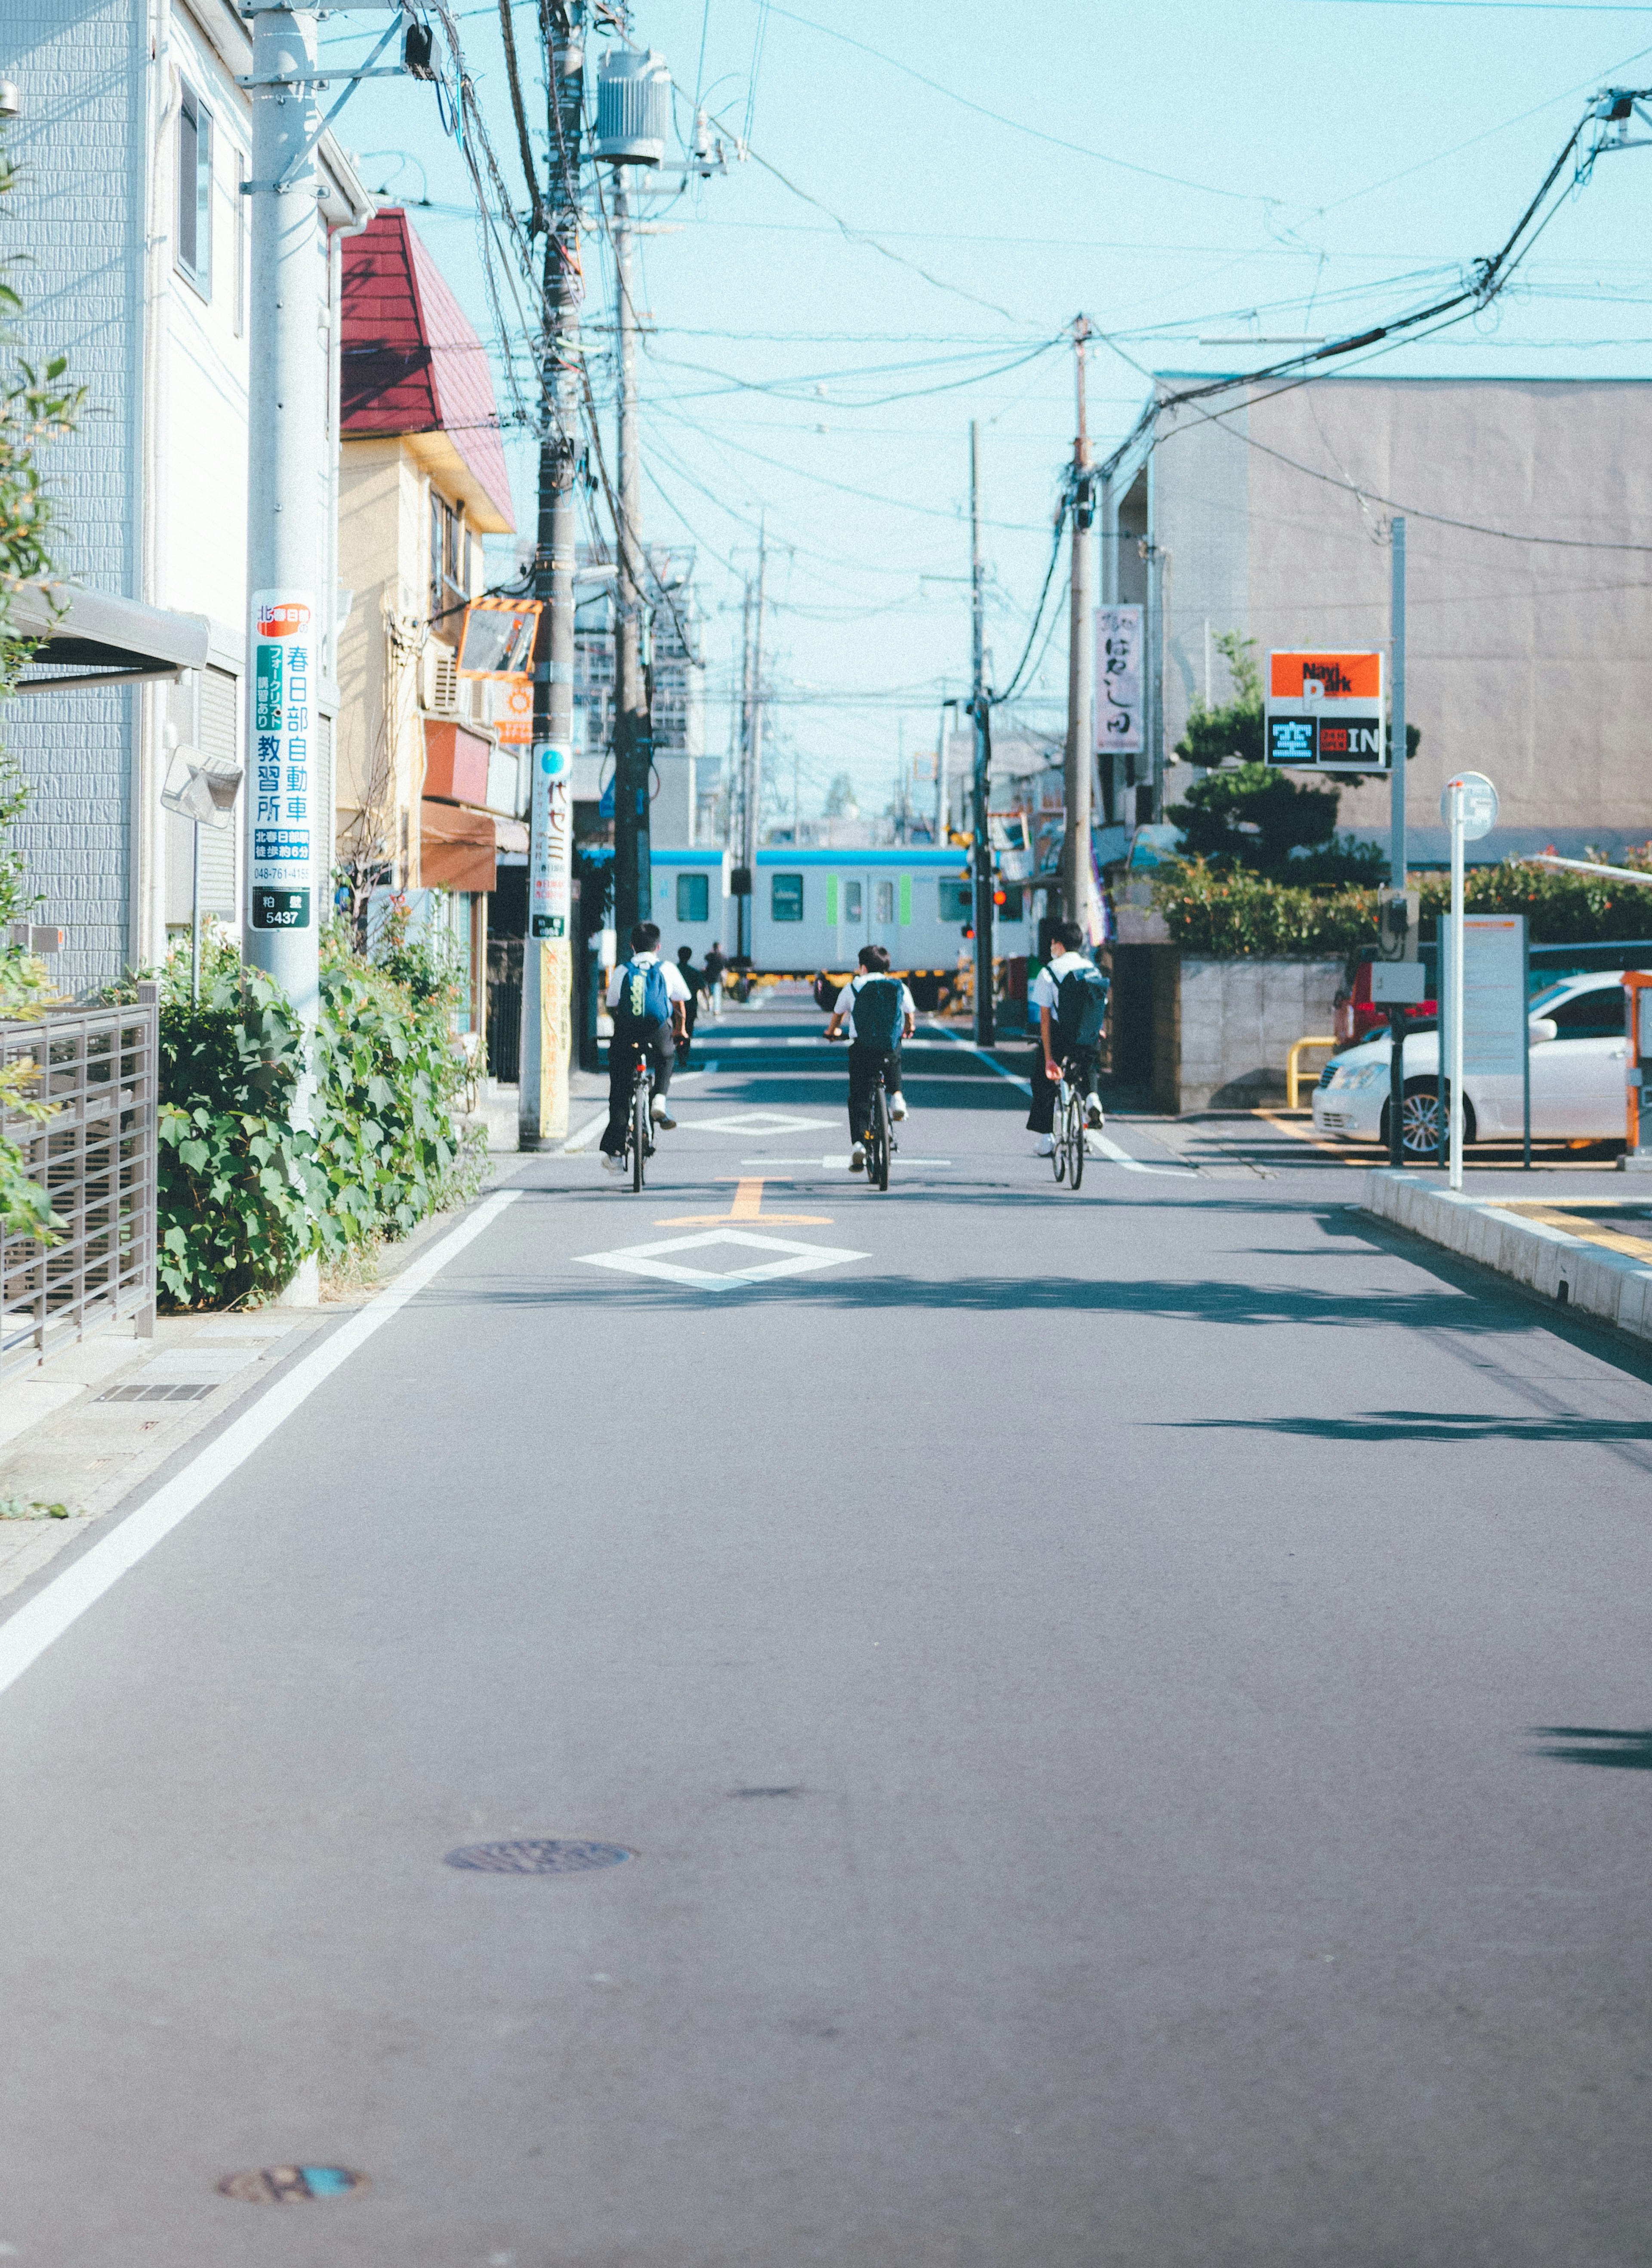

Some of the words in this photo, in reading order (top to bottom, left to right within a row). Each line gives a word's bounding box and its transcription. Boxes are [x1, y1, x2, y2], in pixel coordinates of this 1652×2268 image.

[1303, 663, 1340, 680] Navi
[269, 647, 281, 728] フォークリフト
[286, 646, 308, 822] 春日部自動車
[1272, 721, 1312, 757] 空
[1348, 728, 1379, 753] IN
[257, 735, 280, 822] 教習所
[256, 845, 308, 858] 徒歩約6分
[266, 911, 299, 924] 5437
